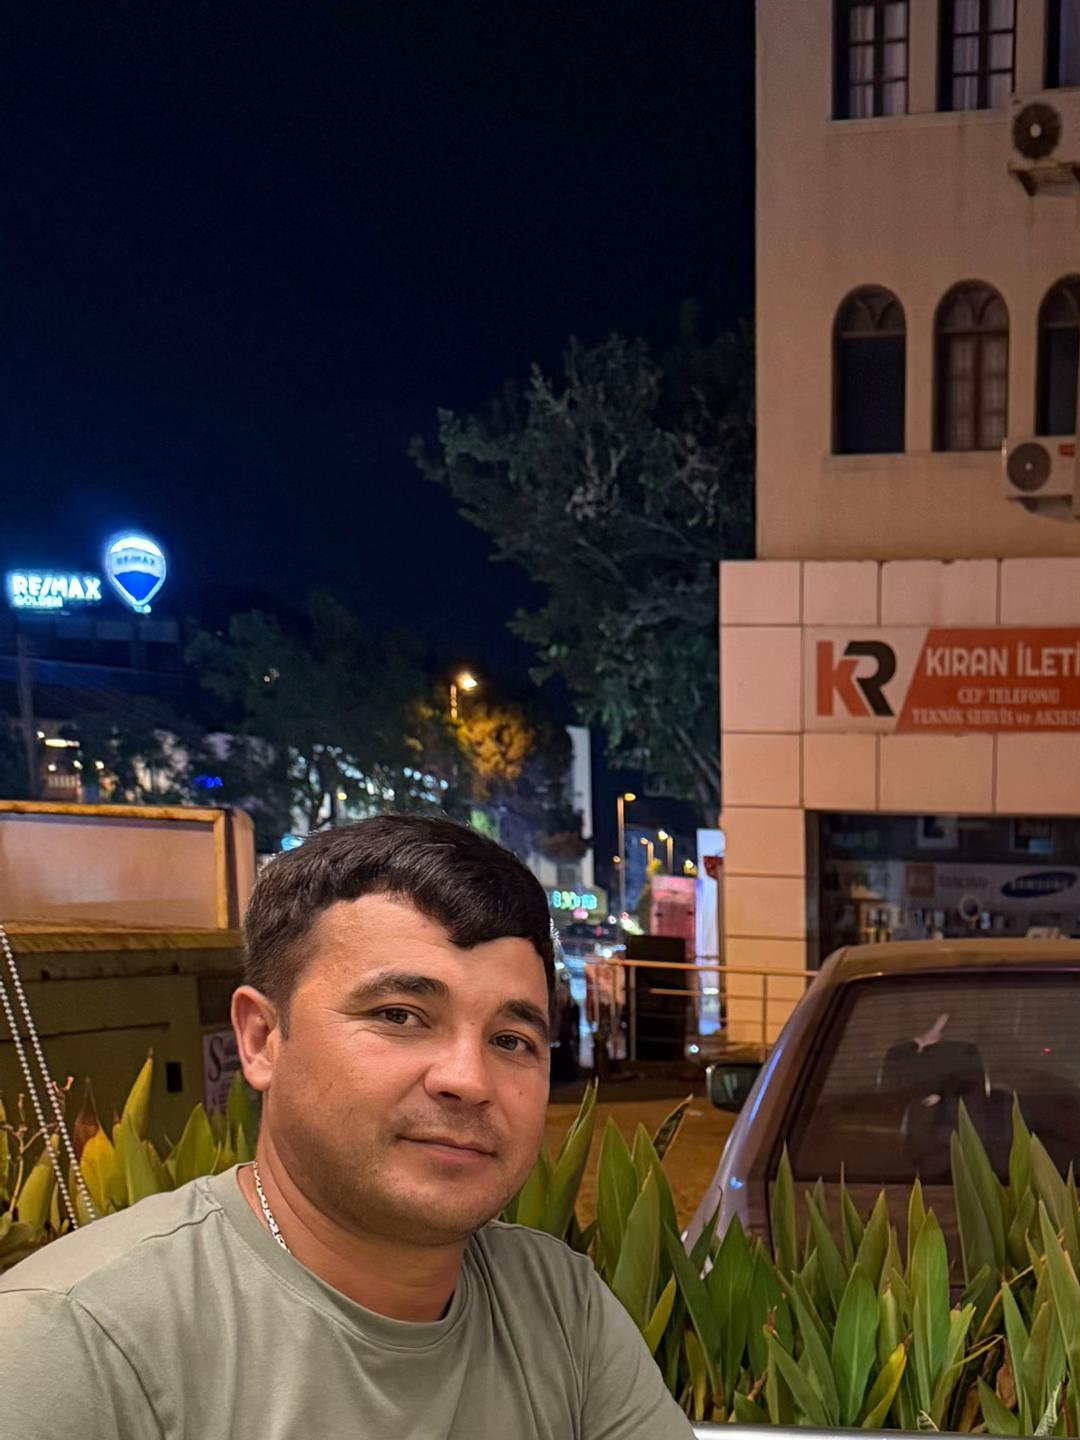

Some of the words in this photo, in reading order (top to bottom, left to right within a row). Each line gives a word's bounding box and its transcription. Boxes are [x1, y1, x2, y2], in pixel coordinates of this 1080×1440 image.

[12, 575, 102, 600] RE/MAX
[925, 647, 1009, 677] KIRAN
[815, 640, 897, 717] KR
